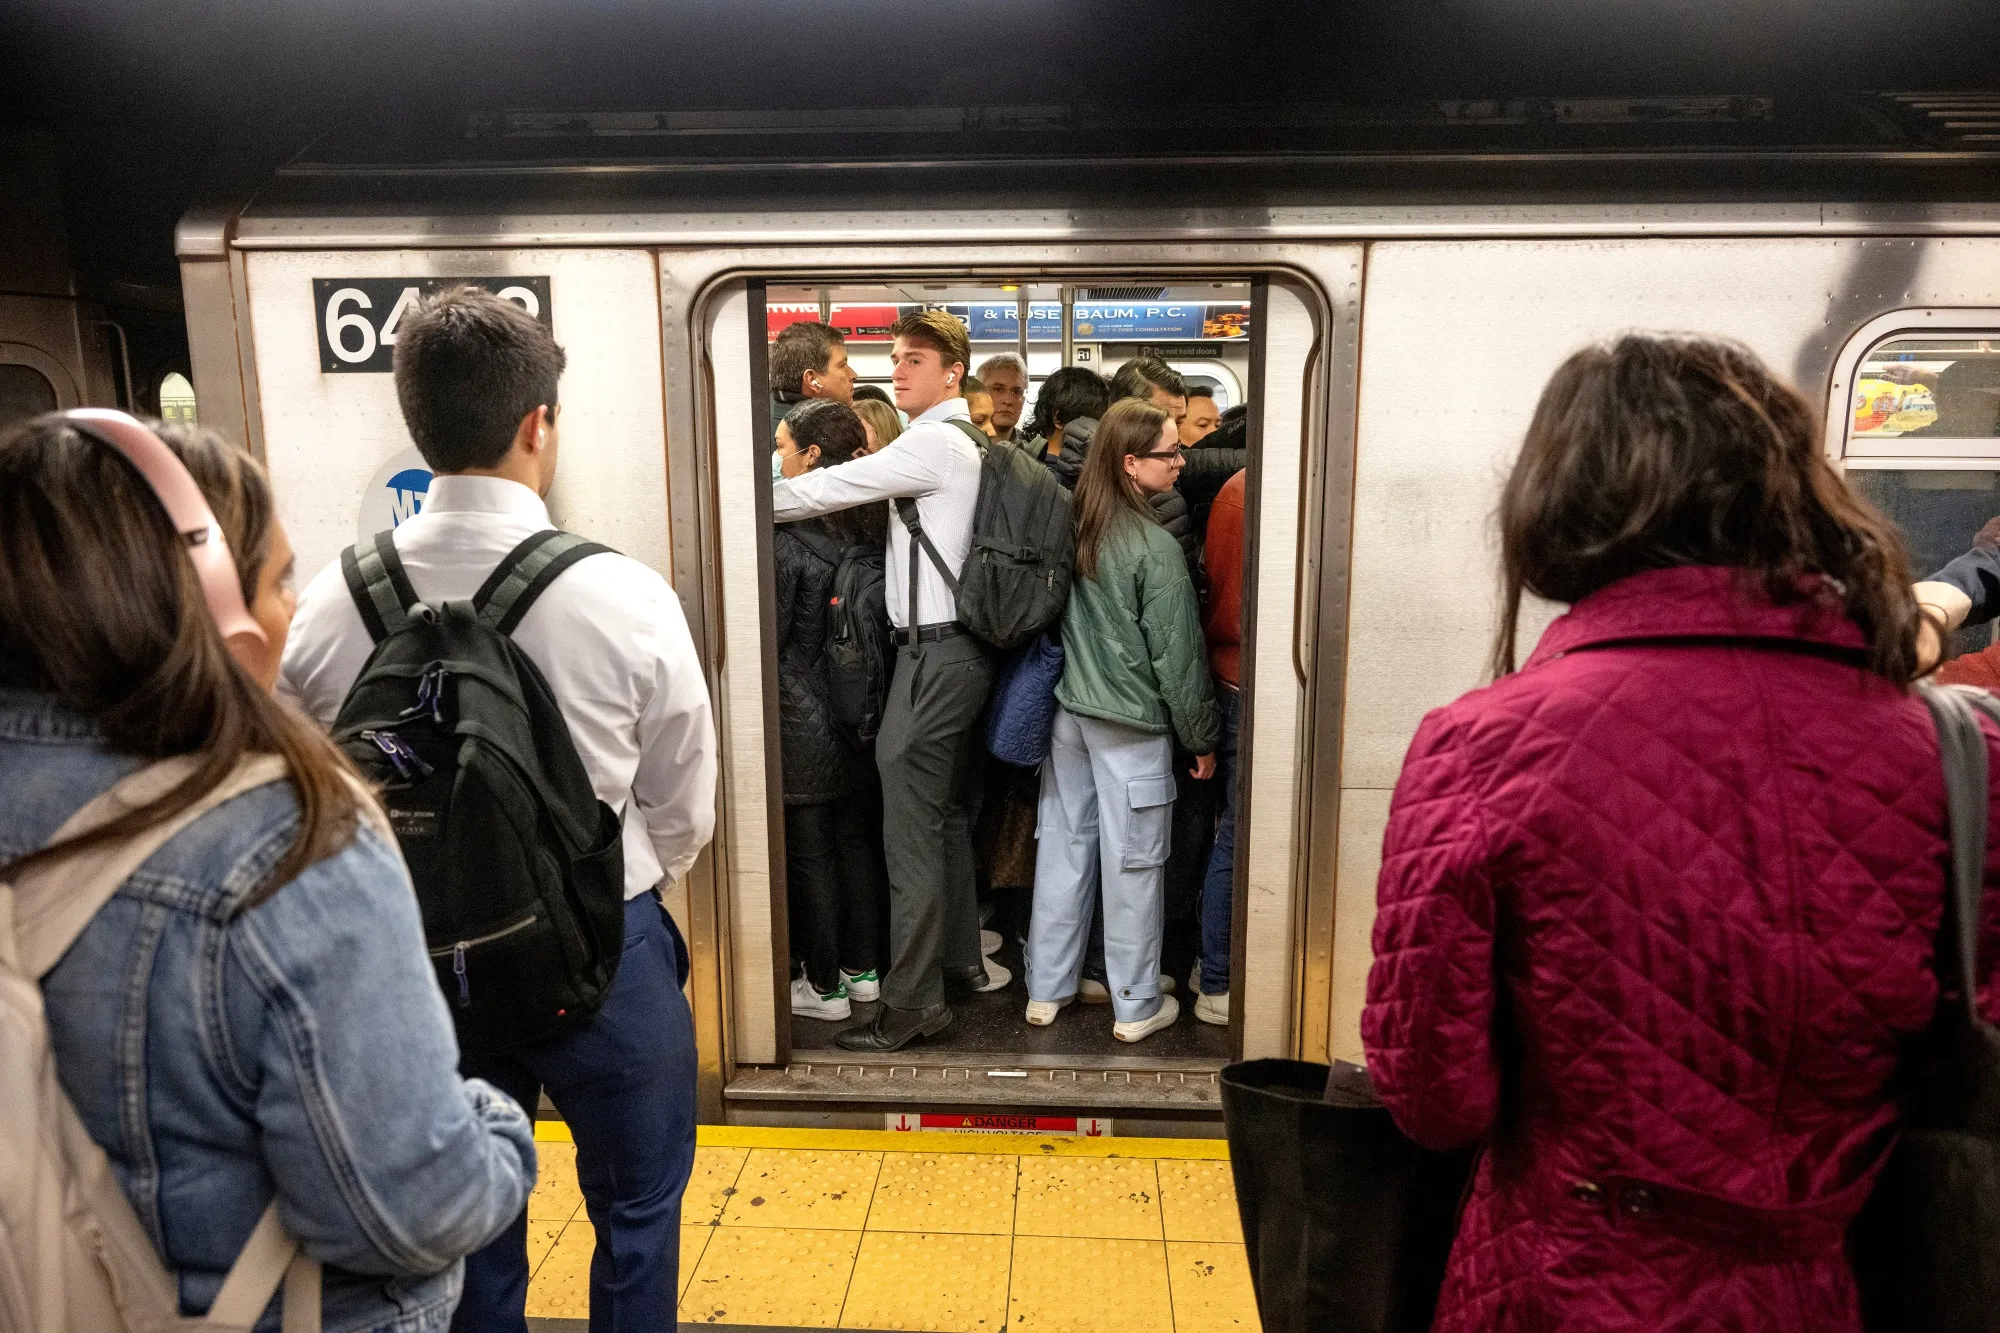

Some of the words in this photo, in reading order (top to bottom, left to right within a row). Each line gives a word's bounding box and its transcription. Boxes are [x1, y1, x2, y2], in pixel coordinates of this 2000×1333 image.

[984, 310, 998, 319] &
[1004, 308, 1138, 319] RSEBAUM,
[1146, 307, 1186, 318] P.C.
[1179, 347, 1195, 355] hold
[1196, 347, 1217, 355] doors
[974, 1116, 1037, 1129] DANGER
